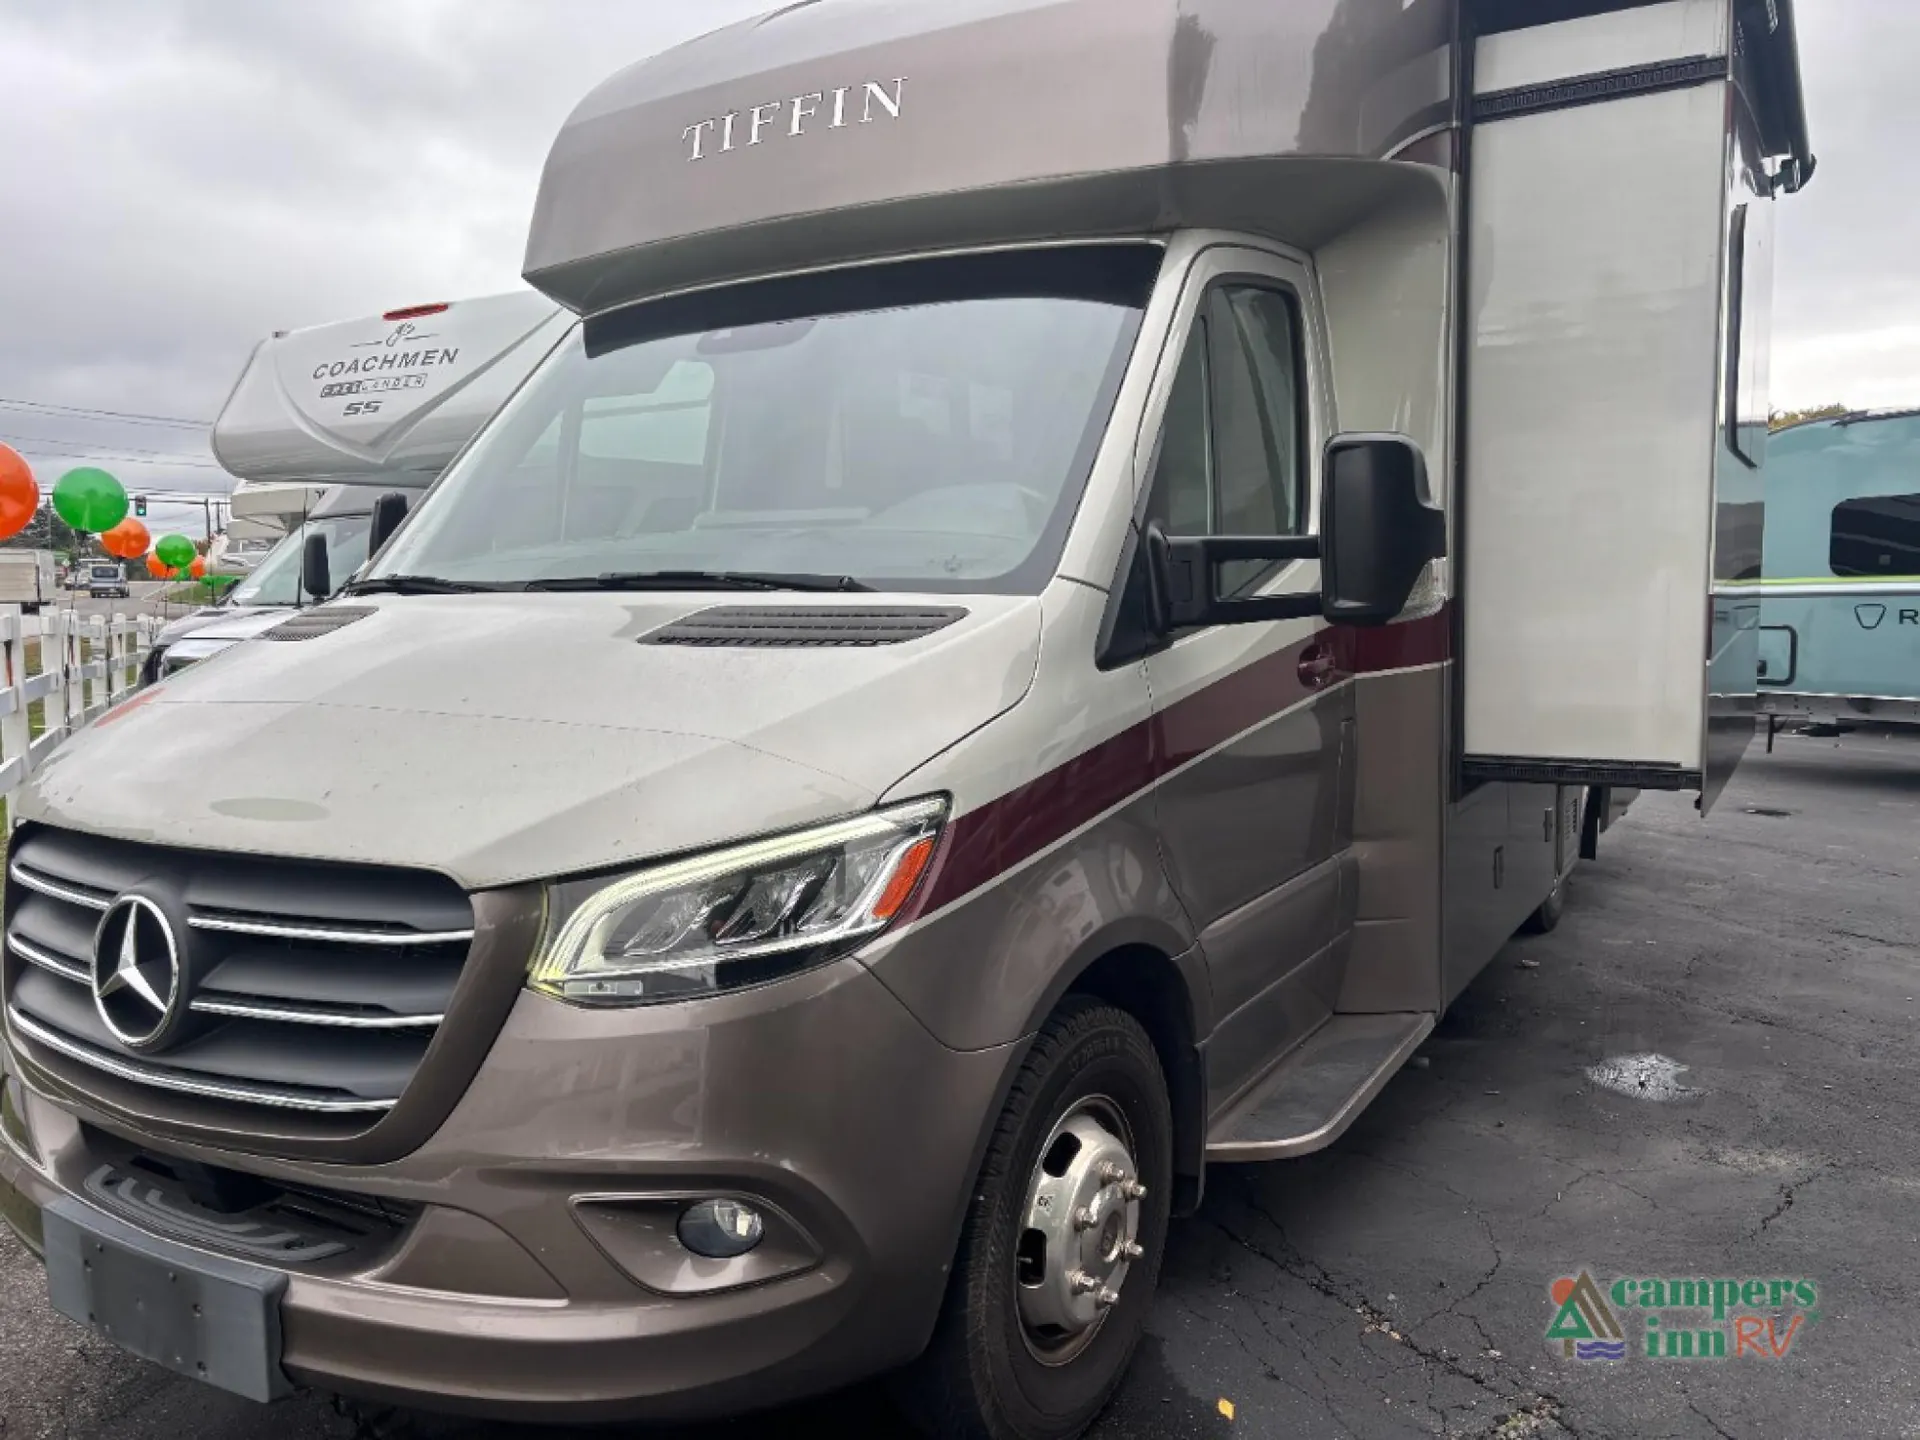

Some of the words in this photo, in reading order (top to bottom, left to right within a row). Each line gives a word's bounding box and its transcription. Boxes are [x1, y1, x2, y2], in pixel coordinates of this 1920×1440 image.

[682, 76, 909, 162] TIFFIN
[313, 348, 459, 379] COACHMEN
[343, 400, 383, 416] SS
[1899, 609, 1919, 625] R
